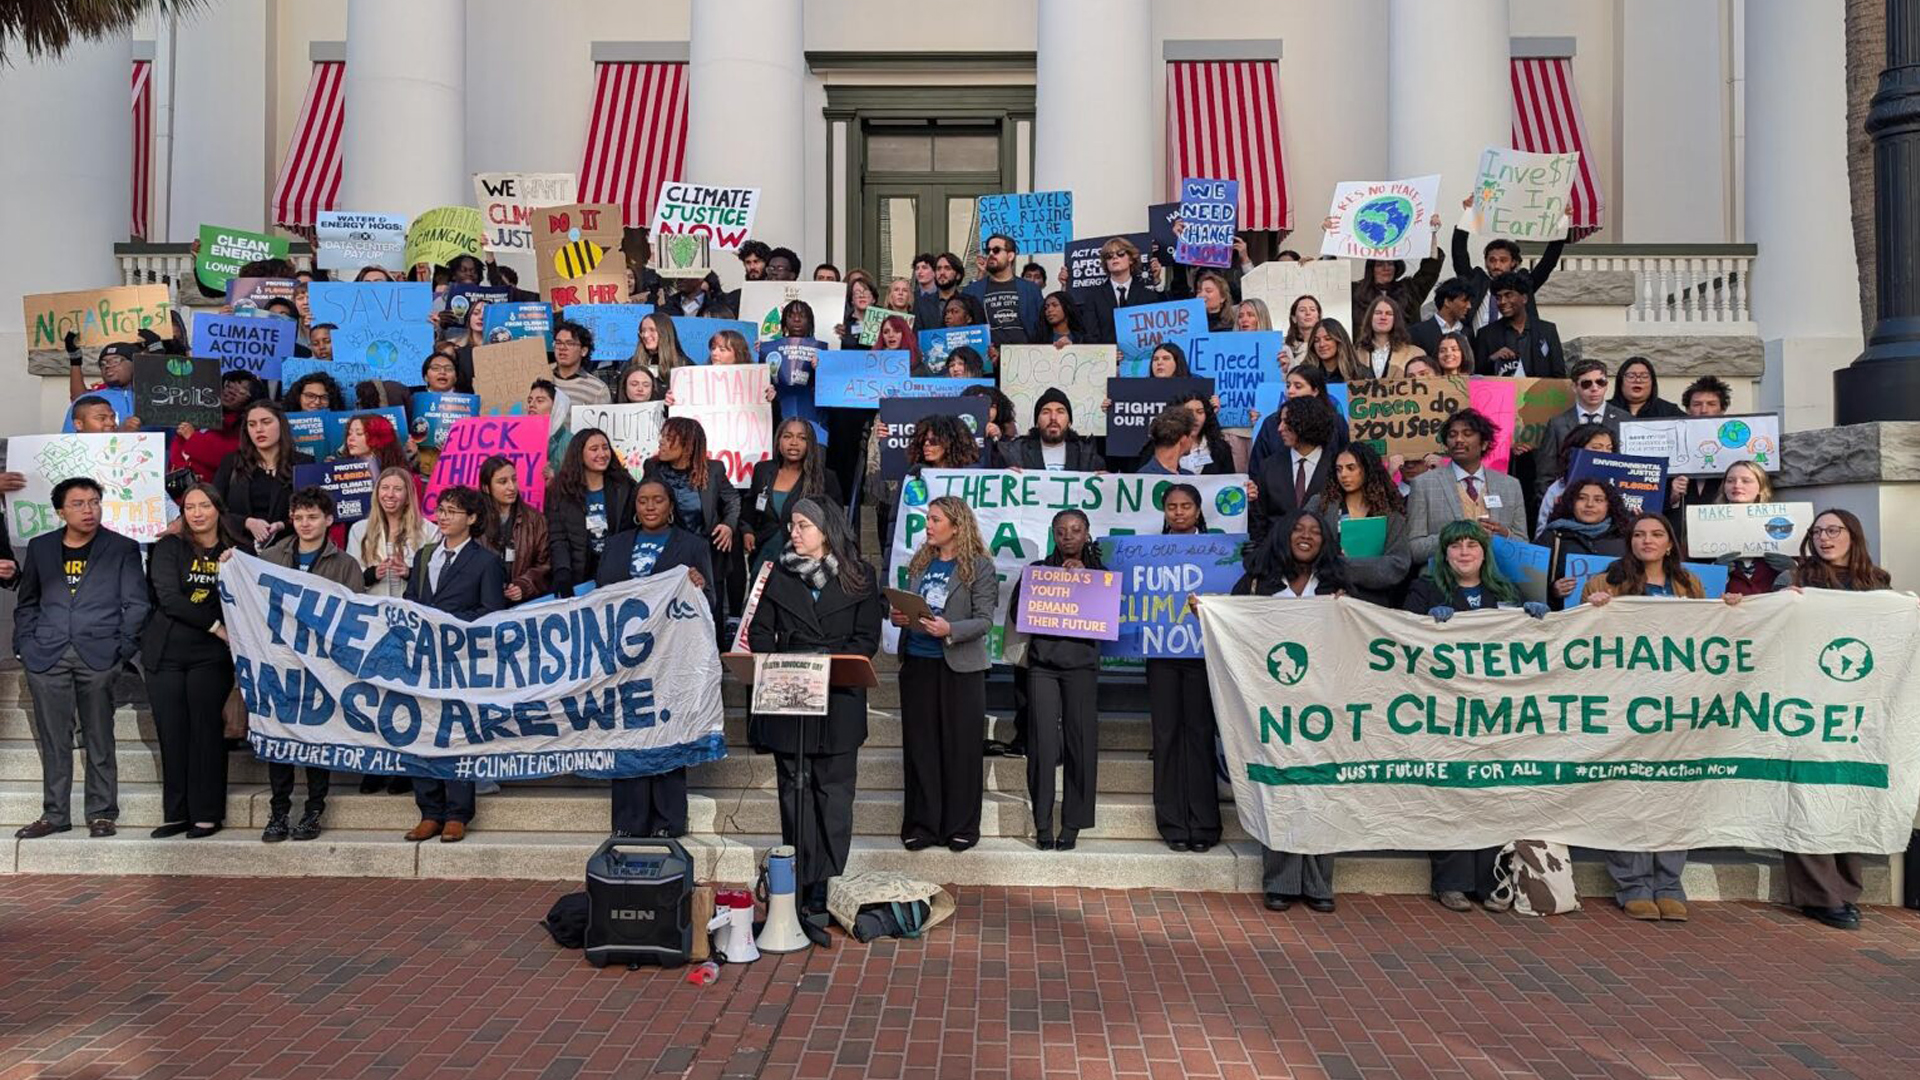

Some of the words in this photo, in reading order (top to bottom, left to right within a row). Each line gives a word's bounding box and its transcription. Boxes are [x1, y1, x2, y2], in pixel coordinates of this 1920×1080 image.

[482, 180, 516, 197] WE
[667, 186, 752, 208] CLIMATE
[1188, 182, 1226, 199] WE
[1368, 185, 1386, 196] NO
[980, 196, 1010, 213] SEA
[1019, 191, 1071, 209] LEVELS
[489, 203, 534, 226] CLIM
[661, 204, 747, 226] JUSTICE
[981, 212, 1009, 227] ARE
[1181, 203, 1234, 221] NEED
[321, 221, 365, 229] ENERGY
[549, 212, 570, 233] DO
[580, 210, 600, 230] IT
[1034, 222, 1061, 237] ARE
[1491, 207, 1560, 237] Earth
[415, 228, 478, 253] CHANGING
[491, 229, 532, 249] JUST
[1182, 222, 1234, 245] CHANGE
[217, 234, 270, 252] CLEAN
[325, 241, 354, 250] DATA
[355, 242, 401, 252] CENTERS
[211, 245, 274, 262] ENERGY
[344, 250, 365, 258] PAY
[1071, 249, 1089, 258] ACT
[1090, 248, 1102, 257] FO
[1073, 277, 1108, 288] ENERGY
[550, 286, 581, 307] FOR
[324, 287, 424, 325] SAVE
[207, 323, 280, 342] CLIMATE
[210, 341, 275, 356] ACTION
[1215, 342, 1259, 371] need
[221, 358, 265, 371] NOW
[672, 368, 768, 405] CLIMATE
[1219, 372, 1264, 389] HUMAN
[1115, 402, 1166, 414] FIGHT
[1219, 391, 1255, 408] CHAN
[1349, 397, 1420, 419] Green
[1430, 391, 1458, 413] do
[1114, 416, 1144, 426] OUR
[443, 422, 520, 452] FUCK
[888, 438, 912, 448] OU
[334, 462, 369, 471] PROTECT
[1593, 458, 1661, 470] ENVIRONMENTAL
[334, 471, 371, 480] FLORIDA
[340, 480, 372, 489] CLIMATE
[342, 487, 372, 495] CHANGE
[936, 475, 1040, 508] THERE
[1048, 477, 1103, 510] IS
[1619, 482, 1659, 490] FLORIDA
[1698, 506, 1733, 520] MAKE
[1747, 504, 1787, 516] EARTH
[1115, 542, 1145, 564] for
[1702, 542, 1731, 553] COOL
[1742, 541, 1779, 553] AGAIN
[1031, 570, 1091, 585] FLORIDA'S
[1133, 563, 1203, 592] FUND
[1030, 585, 1070, 598] YOUTH
[1028, 601, 1079, 615] DEMAND
[1118, 595, 1198, 624] CLIMA
[258, 573, 380, 677] THE
[386, 605, 420, 629] SEAS
[1027, 615, 1059, 628] THEIR
[1062, 619, 1107, 632] FUTURE
[407, 618, 493, 690] ARE
[495, 598, 654, 688] RISING
[781, 660, 811, 670] ADVOCACY
[1369, 638, 1548, 679] SYSTEM
[1563, 635, 1755, 675] CHANGE
[235, 654, 335, 726] AND
[340, 682, 421, 748] SO
[434, 698, 559, 748] ARE
[560, 678, 671, 731] WE.
[1259, 703, 1373, 745] NOT
[1386, 693, 1609, 737] CLIMATE
[1626, 690, 1865, 743] CHANGE!
[265, 739, 331, 770] FUTURE
[333, 747, 363, 769] FOR
[369, 750, 406, 772] ALL
[455, 751, 616, 778] #CLIMATEACTIONNOW
[1336, 763, 1378, 783] JUST
[1467, 763, 1504, 780] FOR
[1511, 762, 1542, 777] ALL
[611, 909, 655, 921] ION
